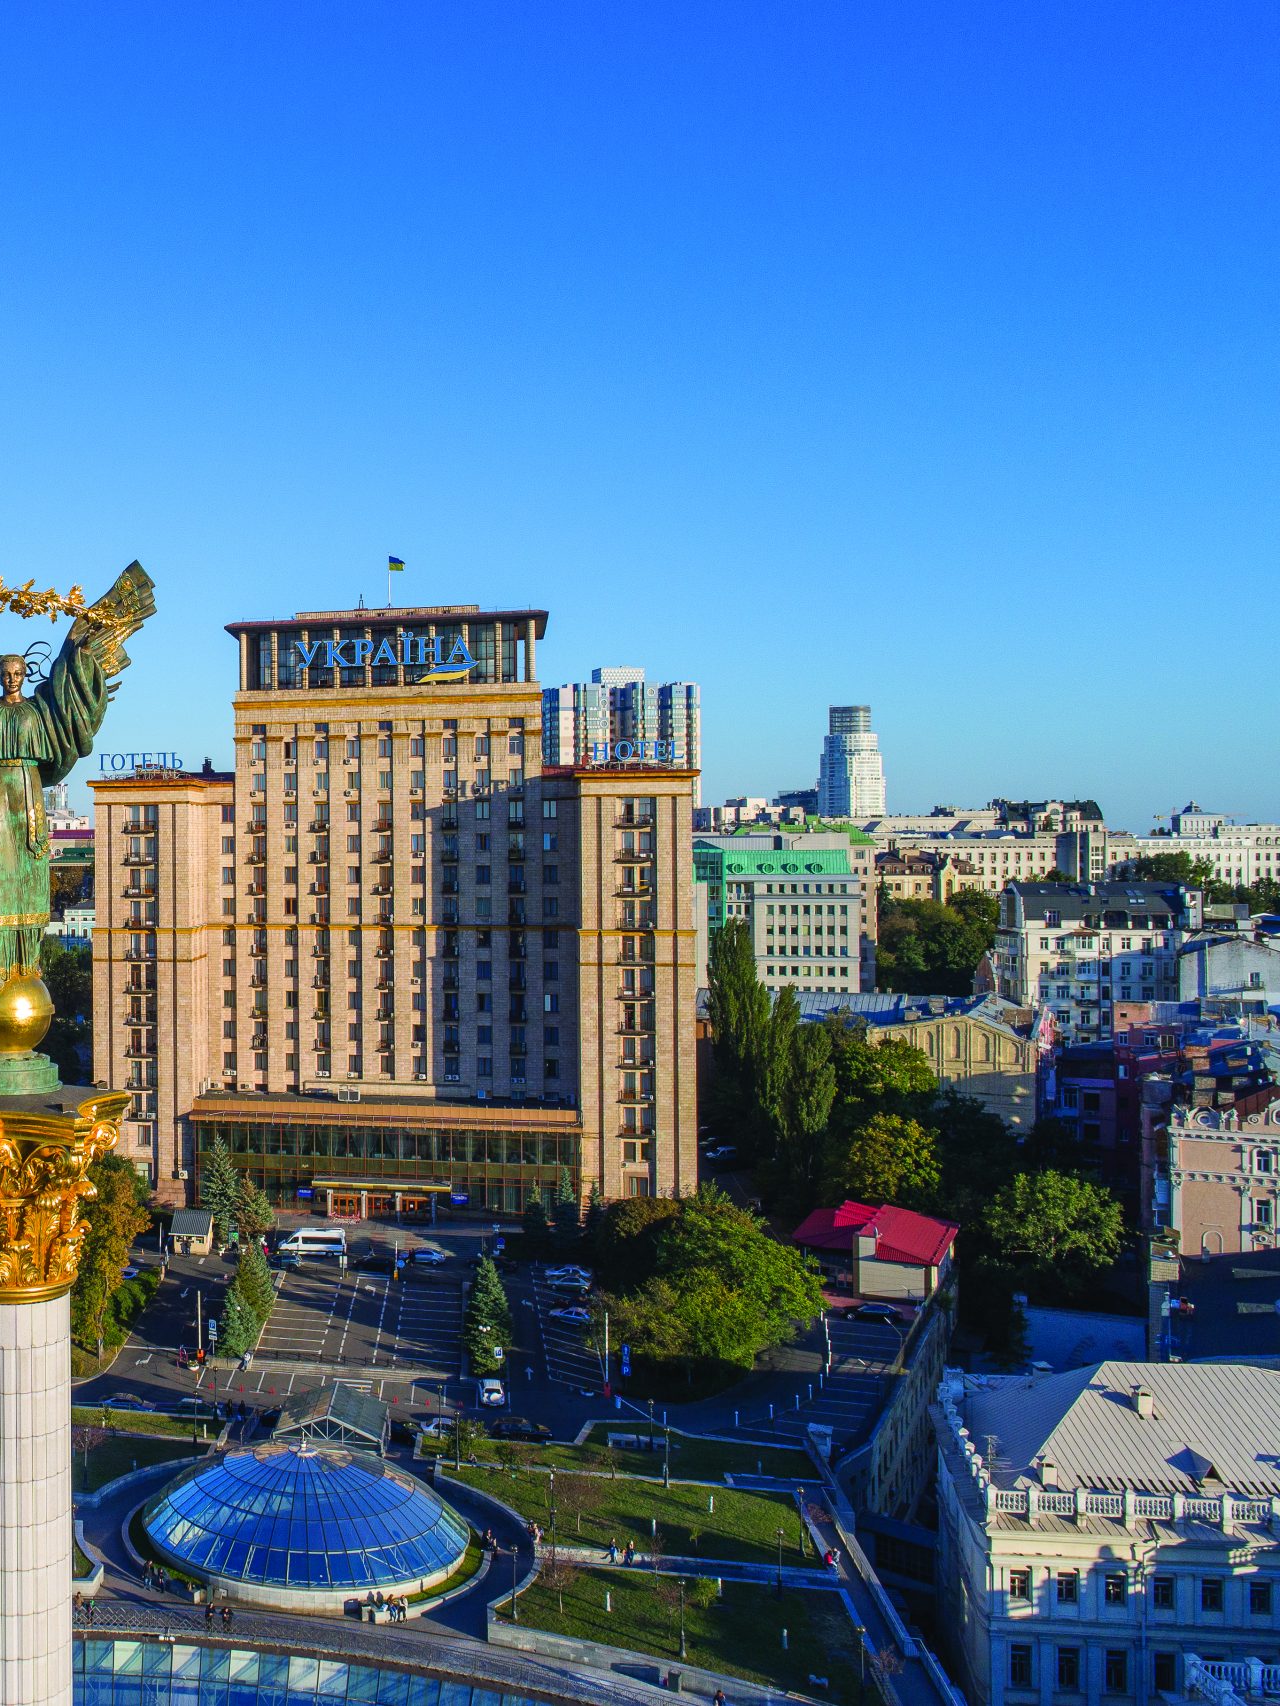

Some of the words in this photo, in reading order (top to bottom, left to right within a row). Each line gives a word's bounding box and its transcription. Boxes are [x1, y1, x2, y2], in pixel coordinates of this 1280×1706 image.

[295, 632, 474, 669] УКРАЇНА
[593, 740, 684, 760] HOTEL
[99, 752, 183, 770] ГОТЕЛЬ
